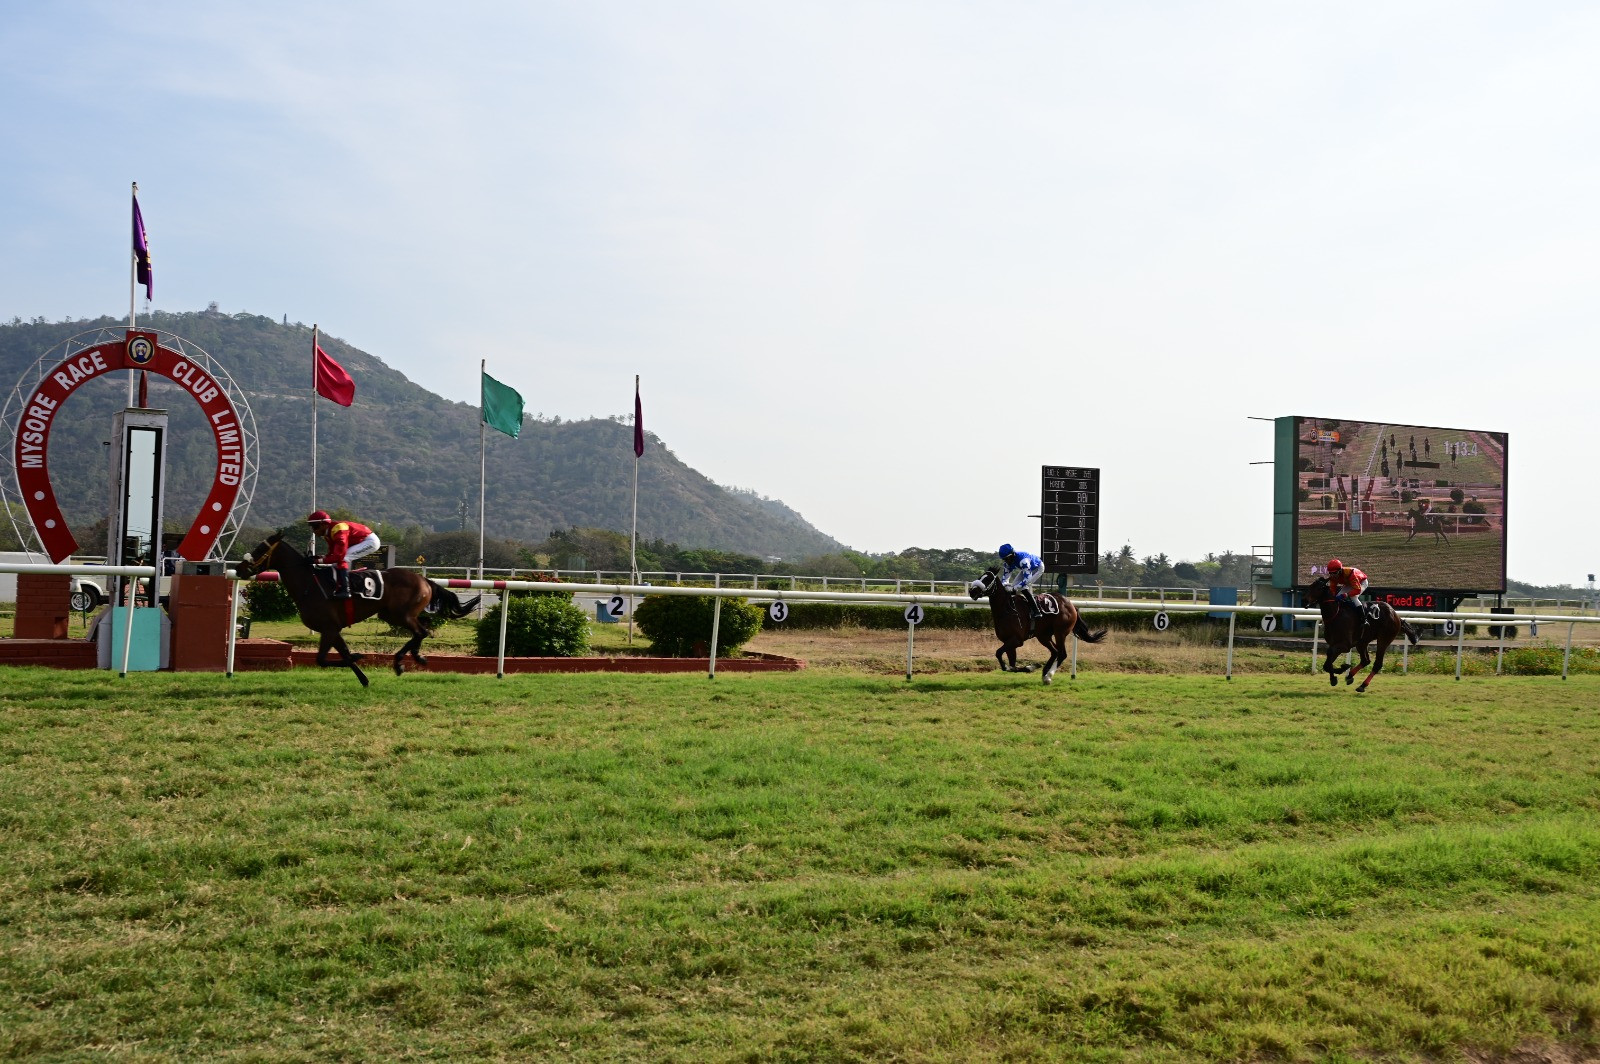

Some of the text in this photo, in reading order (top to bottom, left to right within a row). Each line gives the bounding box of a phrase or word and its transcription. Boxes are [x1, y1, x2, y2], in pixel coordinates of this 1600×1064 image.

[22, 350, 241, 486] MYSORE RACE CLUB LIMITED
[1443, 440, 1478, 457] 1:13.4
[1077, 492, 1088, 503] EVEN
[364, 577, 376, 597] 9
[610, 596, 624, 616] 2
[1044, 597, 1056, 612] 2
[1386, 594, 1412, 607] Fixed
[1415, 596, 1424, 607] at
[773, 601, 785, 621] 3
[906, 605, 920, 623] 4
[1157, 613, 1167, 629] 6
[1264, 616, 1274, 632] 7
[1446, 620, 1454, 635] 9
